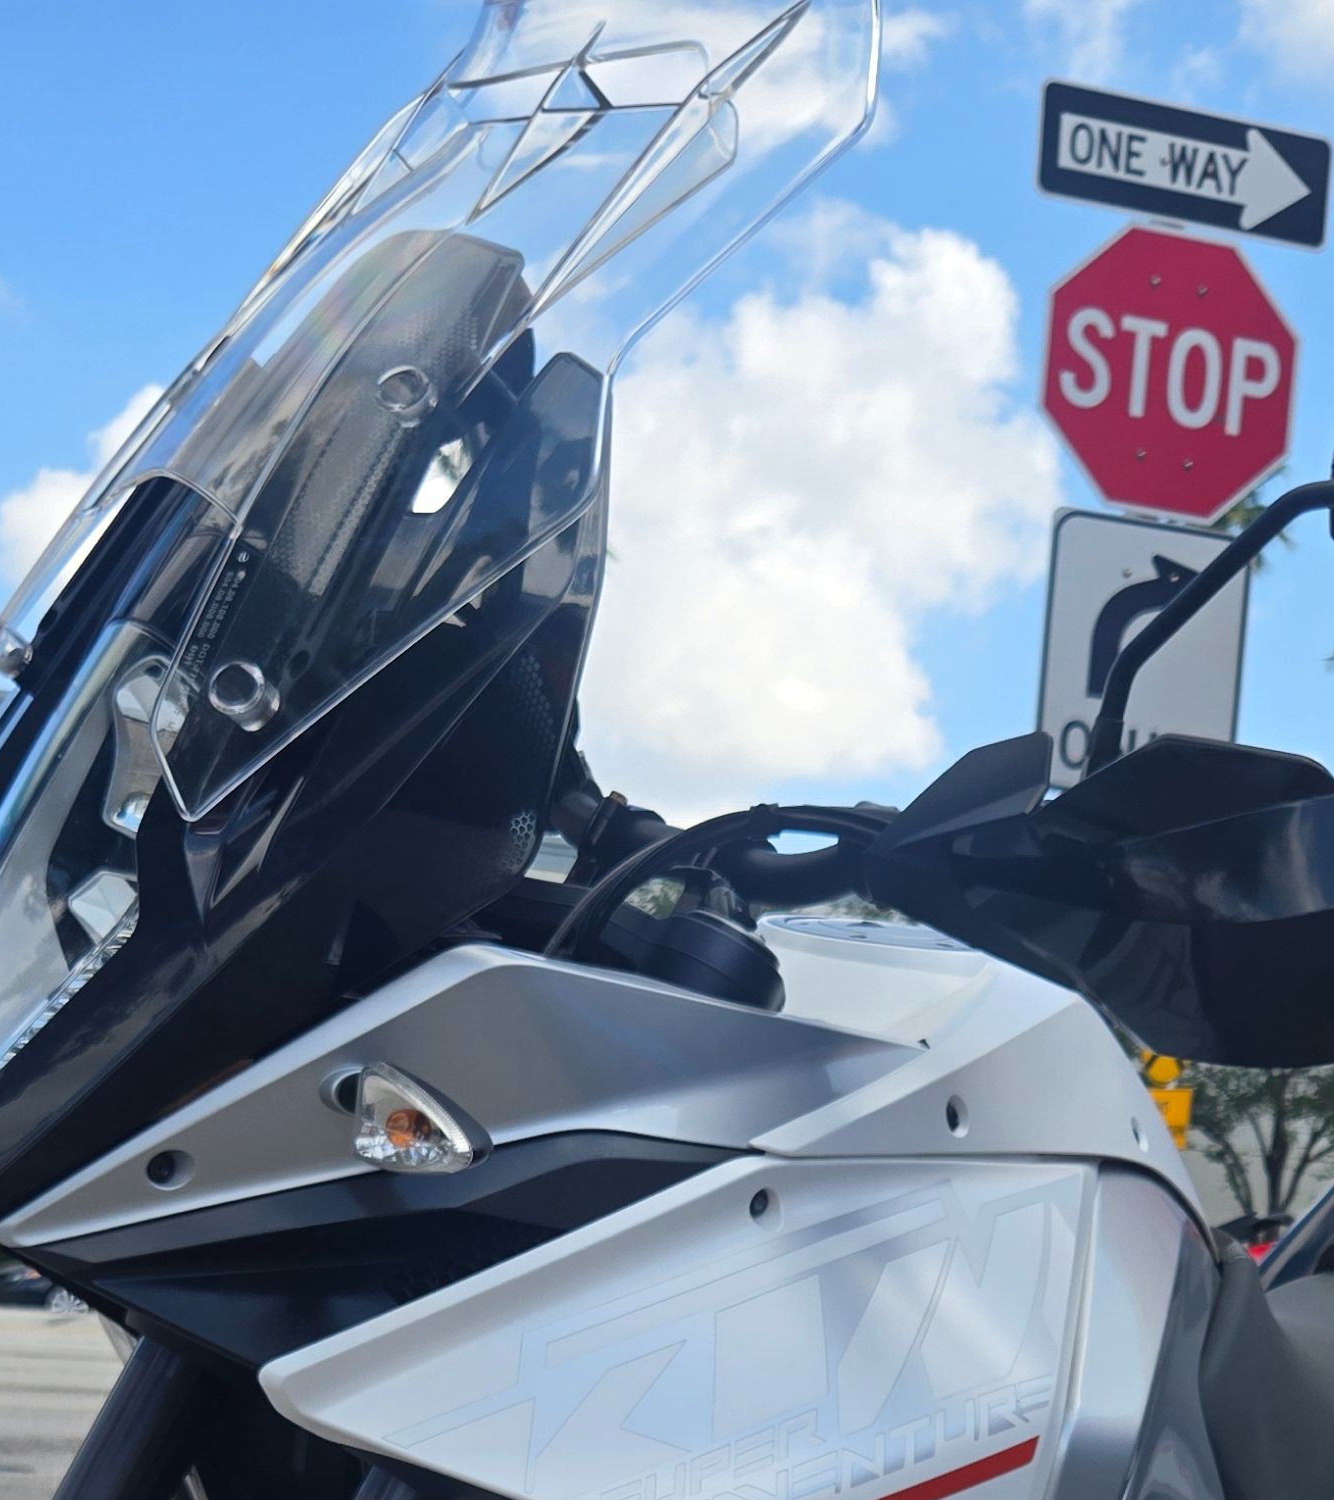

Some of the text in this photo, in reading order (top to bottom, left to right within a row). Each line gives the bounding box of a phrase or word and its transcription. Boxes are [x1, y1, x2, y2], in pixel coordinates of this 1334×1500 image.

[1068, 122, 1248, 197] ONE WAY
[1058, 307, 1282, 437] STOP
